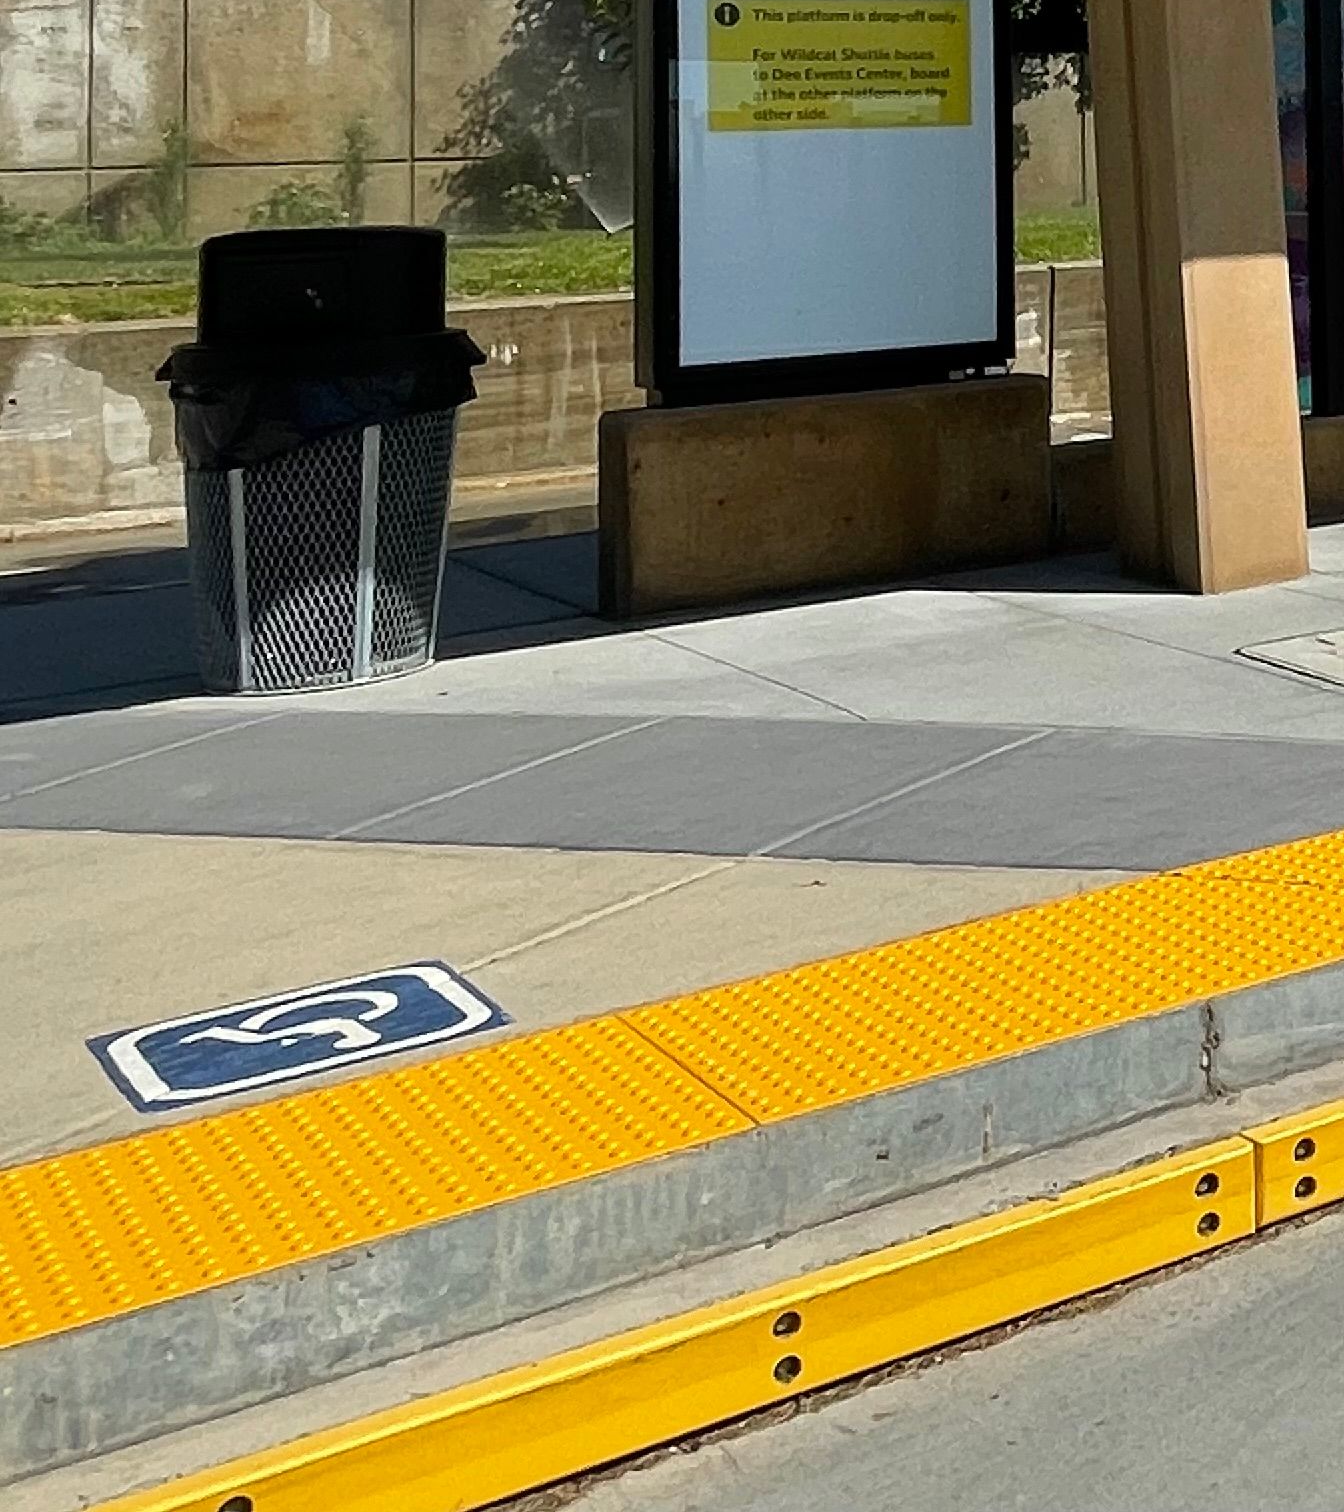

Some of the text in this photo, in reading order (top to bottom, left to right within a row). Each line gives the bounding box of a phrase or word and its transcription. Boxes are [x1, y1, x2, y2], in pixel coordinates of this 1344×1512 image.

[752, 8, 961, 25] This platform is drop-off only.
[752, 48, 935, 61] For Wildcat Shuttle buses
[752, 67, 950, 82] to Dee Events Center, board
[752, 89, 768, 102] at
[771, 88, 796, 101] the
[799, 87, 837, 100] other
[752, 106, 830, 121] other side.
